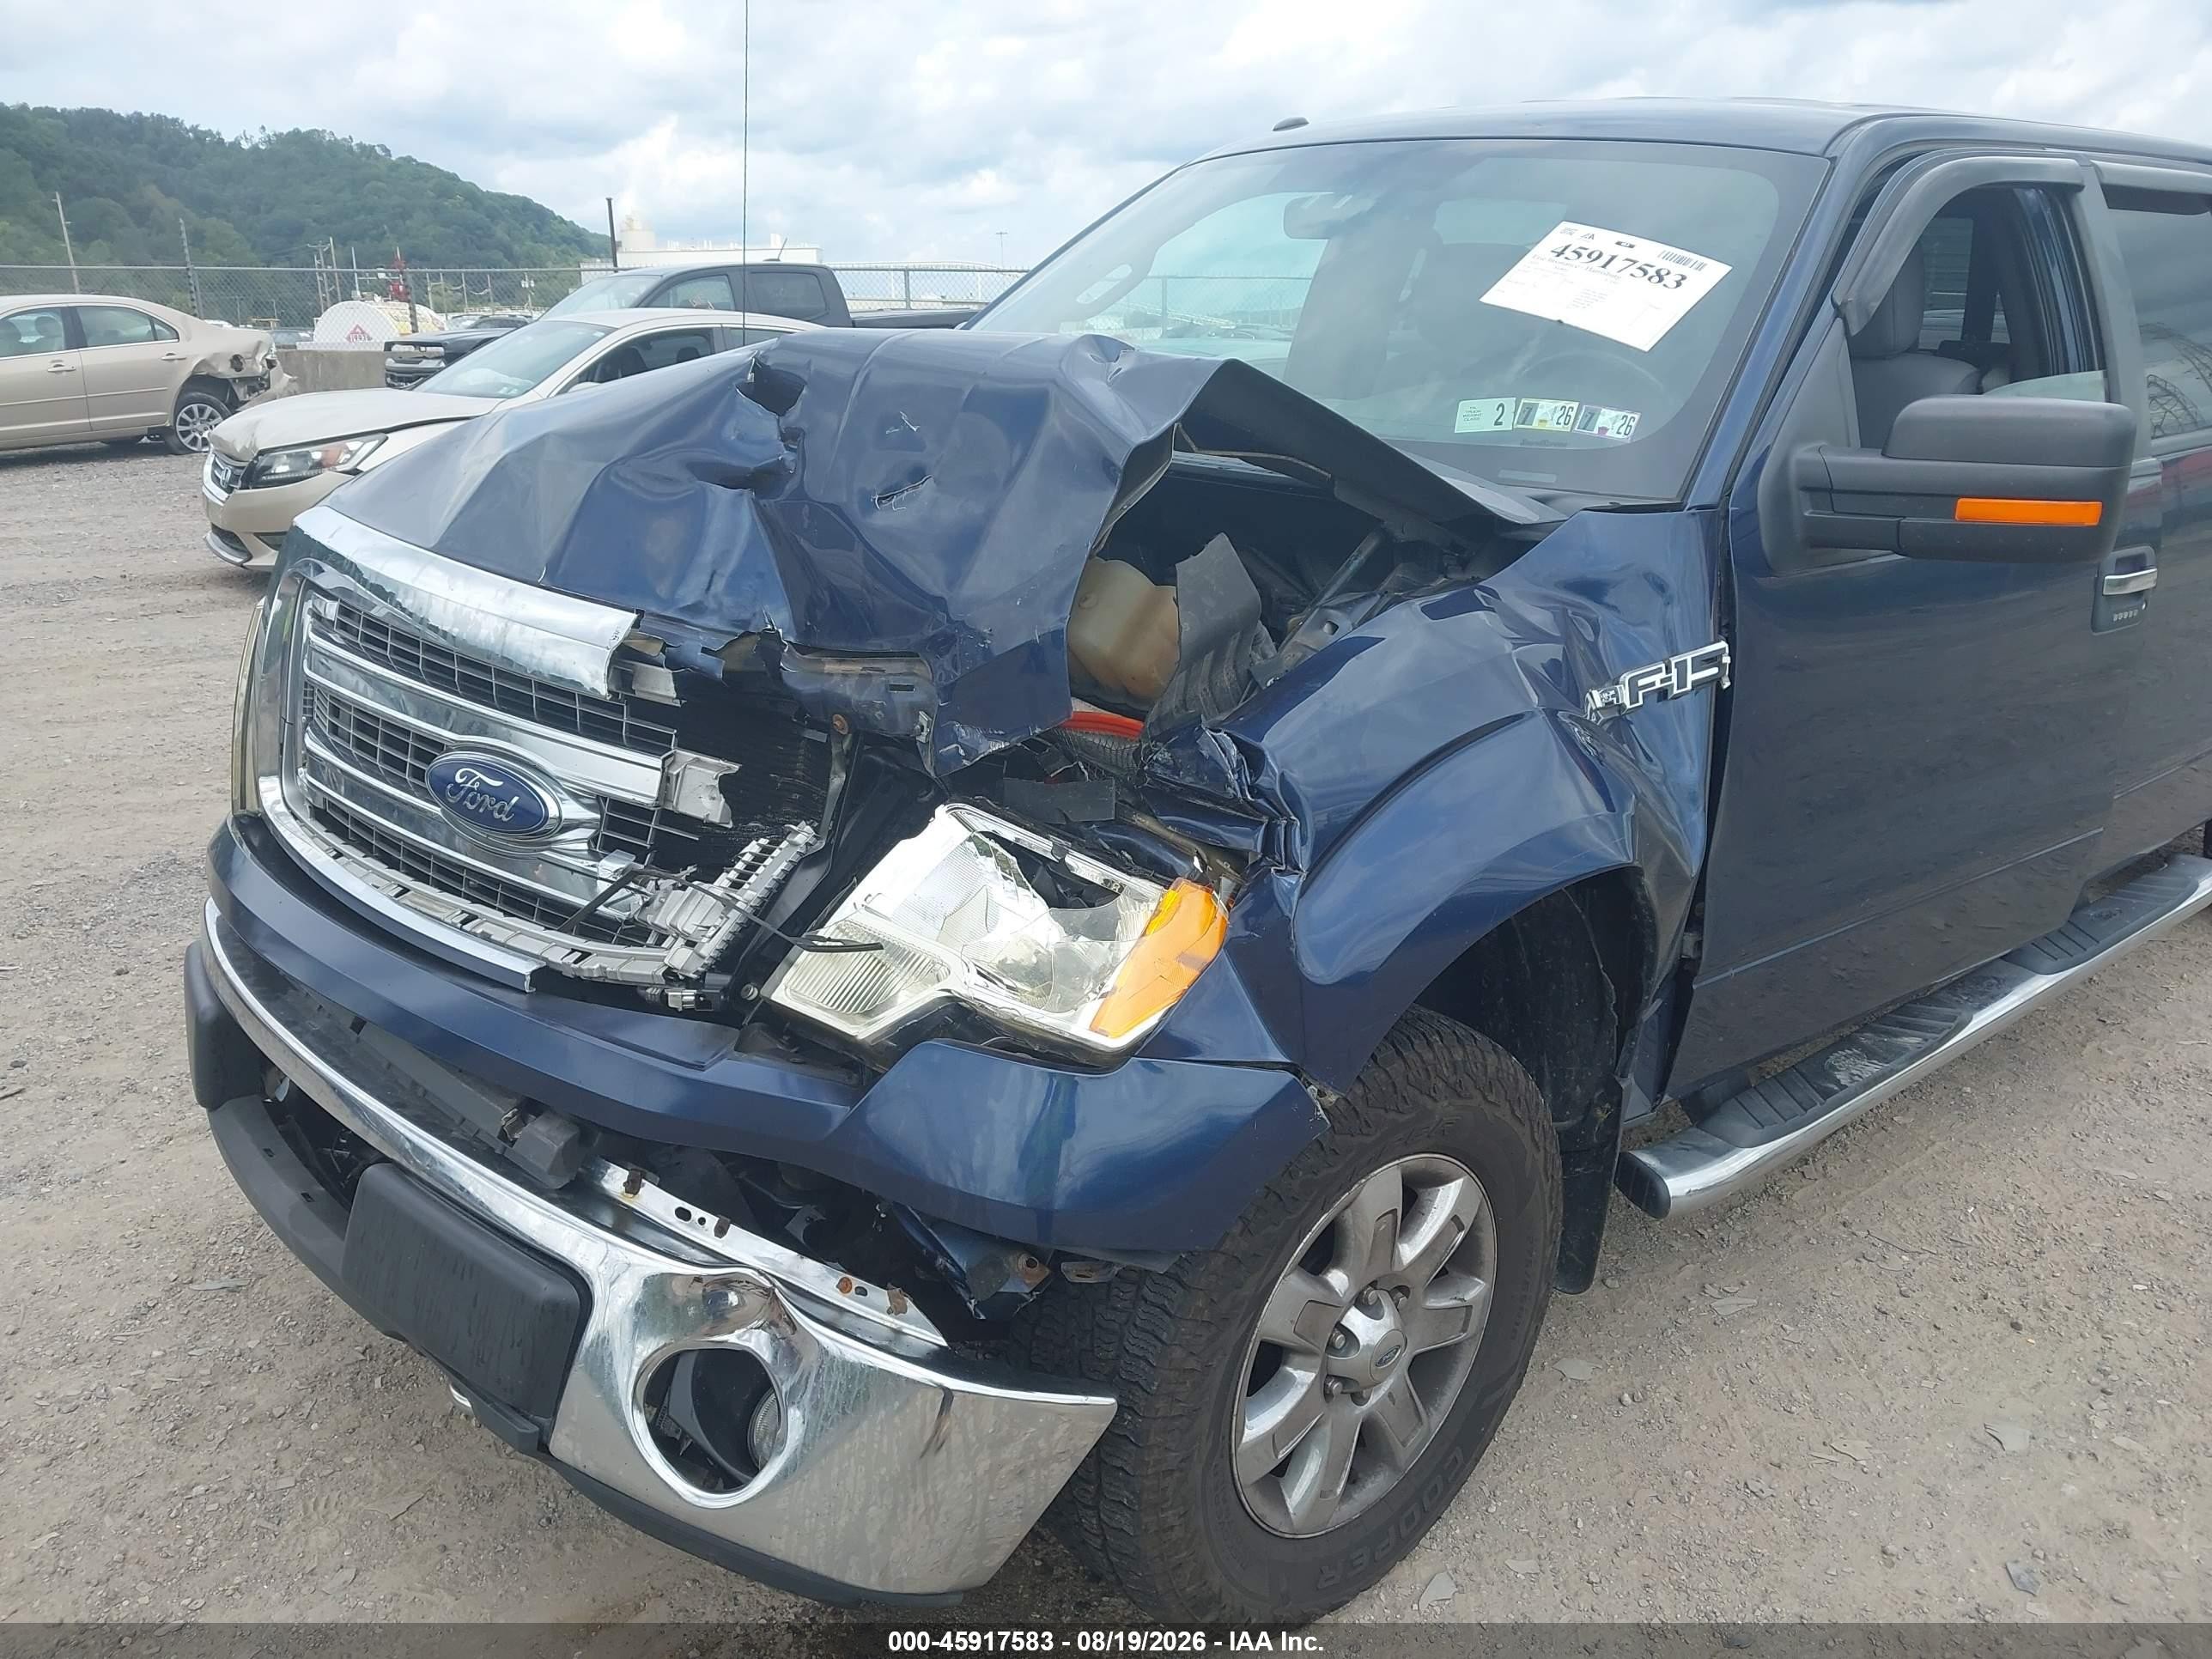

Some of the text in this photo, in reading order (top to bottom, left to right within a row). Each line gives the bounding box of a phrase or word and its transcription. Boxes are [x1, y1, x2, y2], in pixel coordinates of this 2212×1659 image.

[1550, 243, 1687, 289] 45917583
[1493, 402, 1505, 427] 2
[1555, 405, 1574, 426] 26
[1616, 414, 1636, 436] 26
[445, 767, 520, 823] Ford
